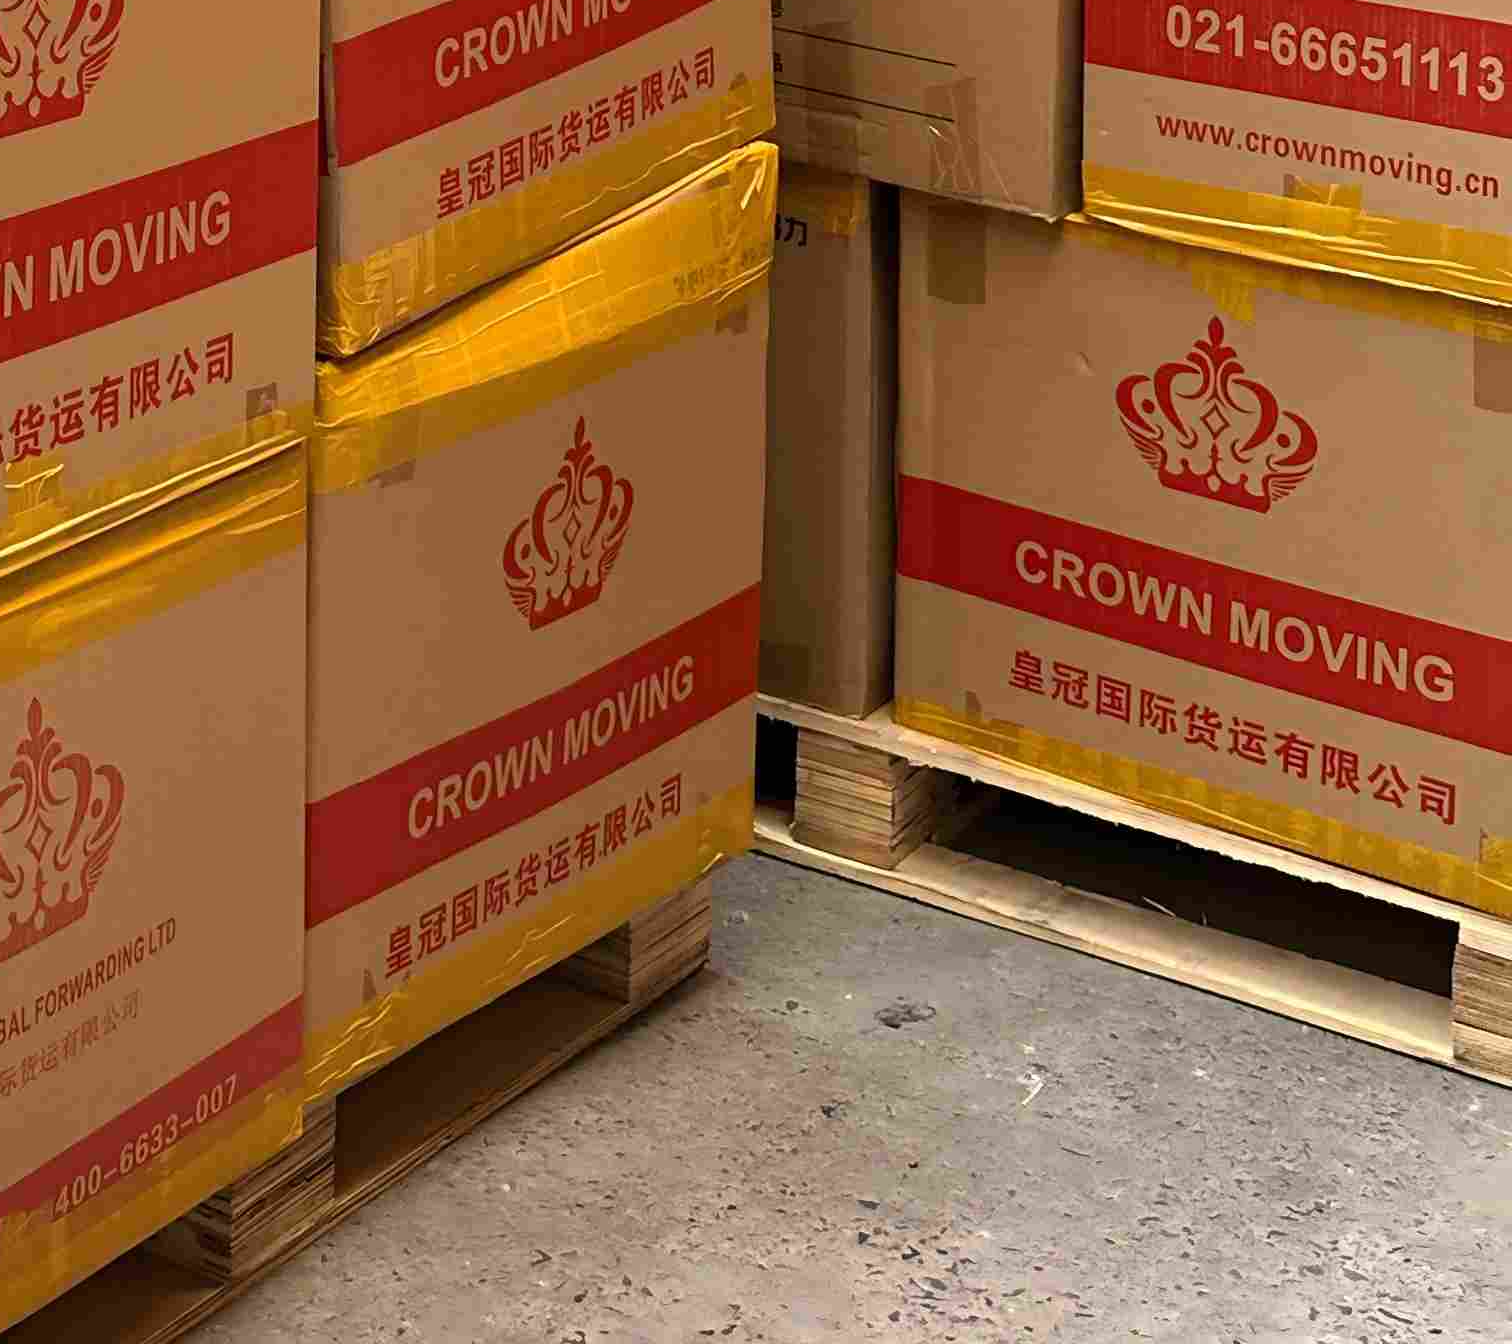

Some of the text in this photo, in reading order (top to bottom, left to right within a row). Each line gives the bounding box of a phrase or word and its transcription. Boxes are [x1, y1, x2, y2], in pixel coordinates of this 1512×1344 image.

[437, 46, 715, 220] 皇冠国际货运有限公司
[1165, 4, 1506, 103] 021-66651113
[1155, 113, 1501, 200] www.crownmoving.cn
[48, 189, 232, 302] MOVING
[1014, 540, 1457, 704] CROWN MOVING
[406, 654, 695, 840] CROWN MOVING
[1008, 649, 1458, 827] 皇冠国际货运有限公司
[384, 773, 683, 980] 皇冠国际货运有限公司
[34, 940, 146, 1024] FORWARDING
[147, 916, 178, 956] LTD
